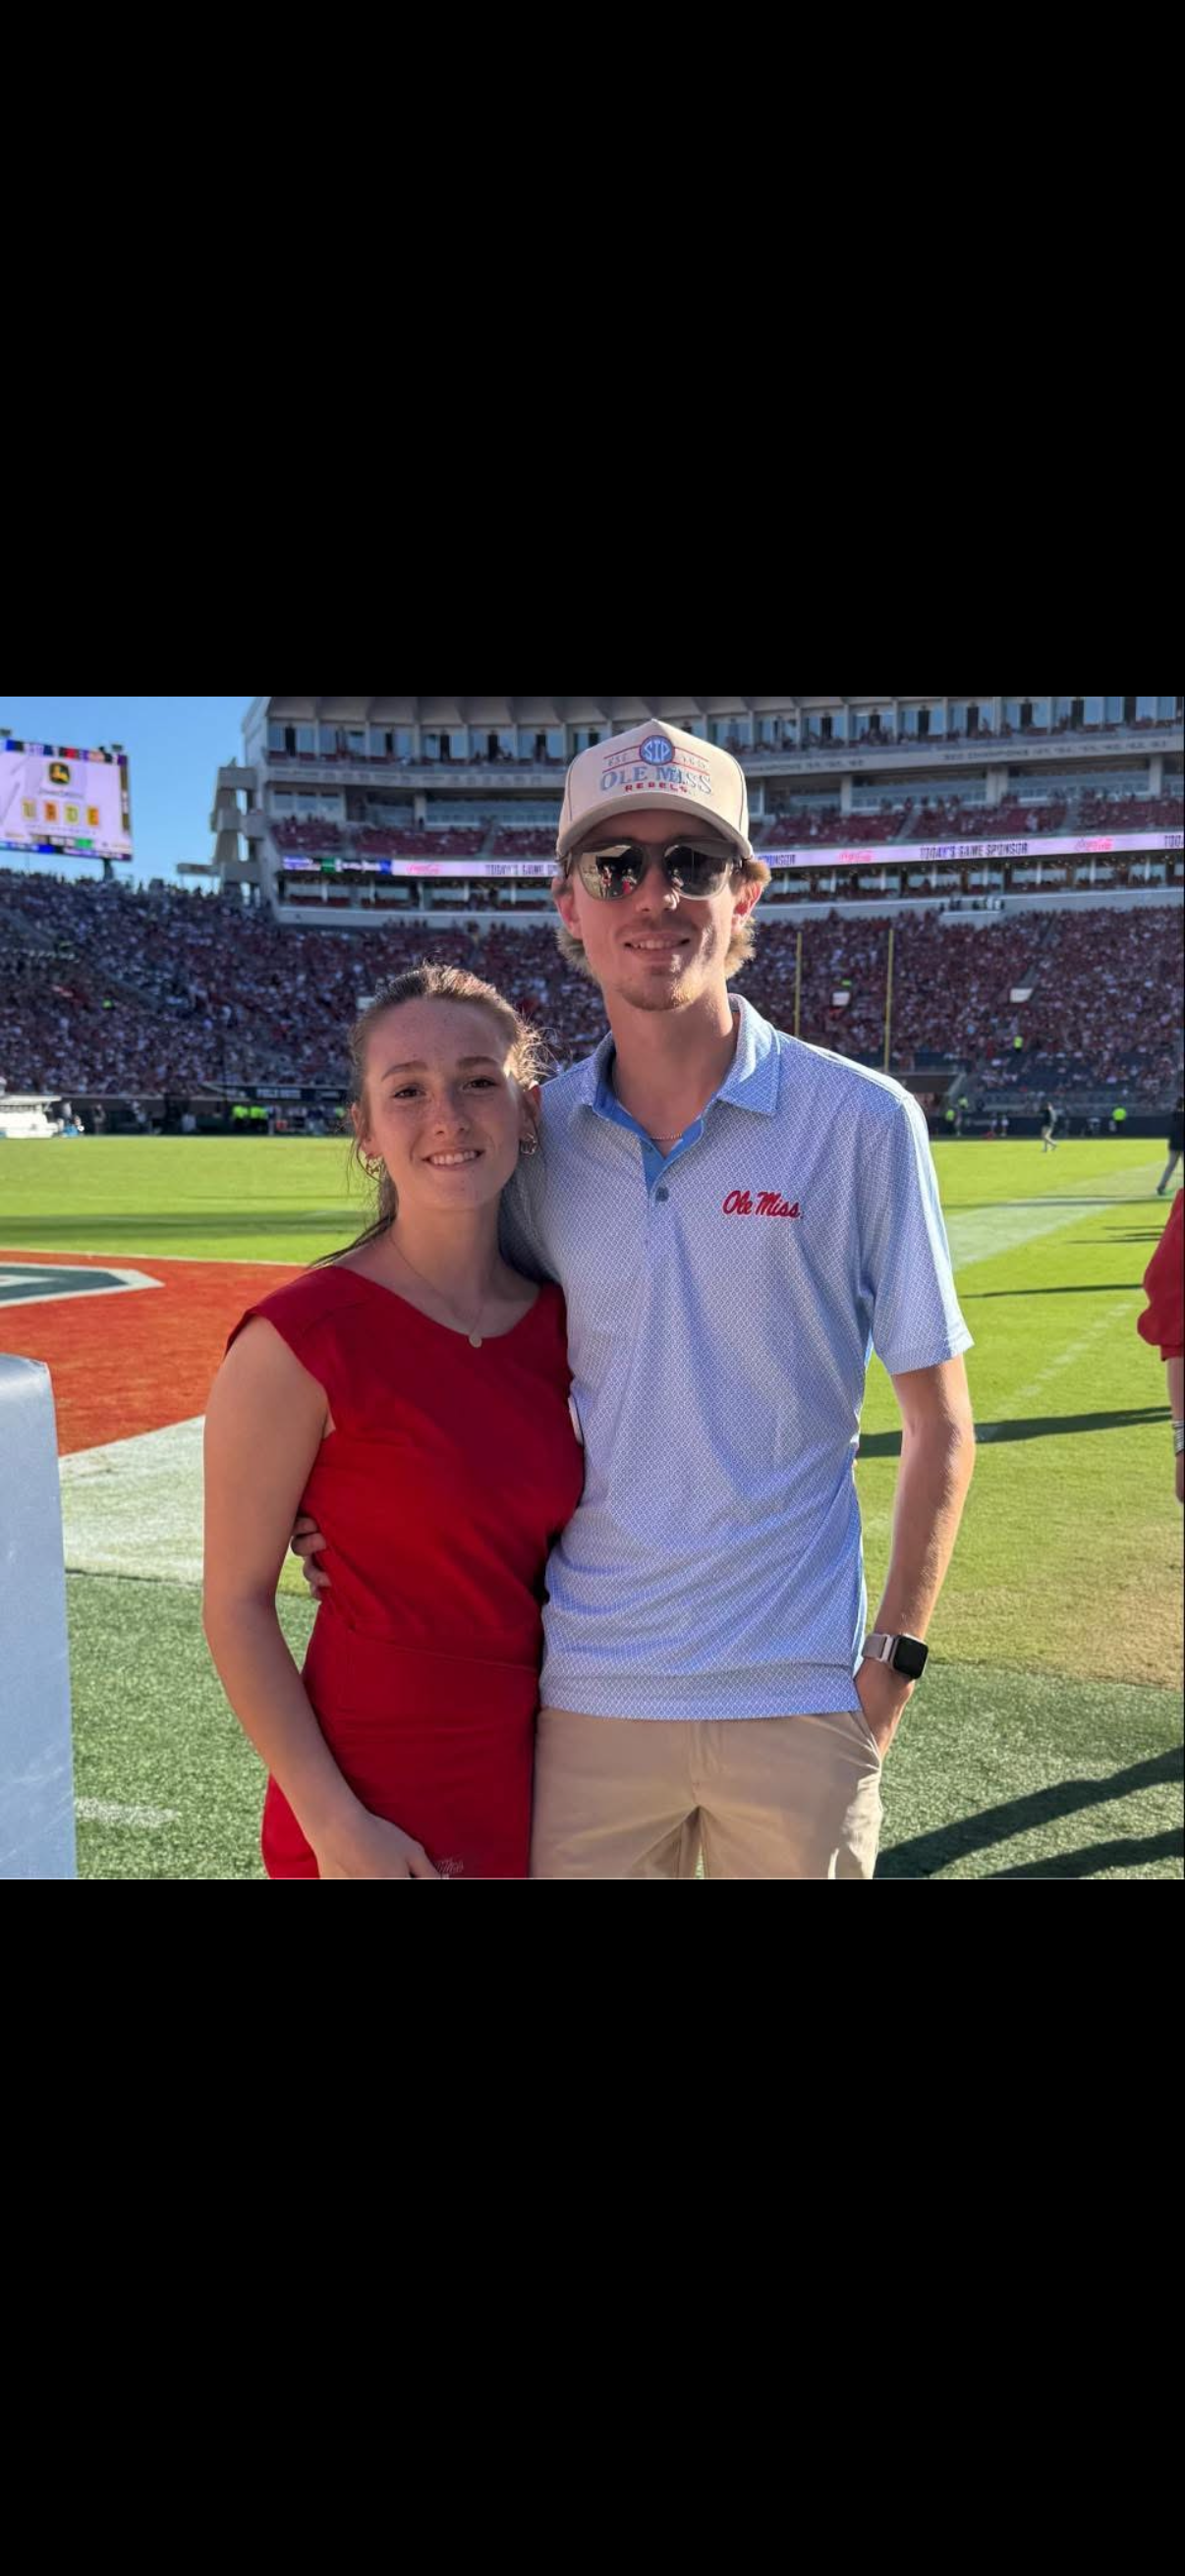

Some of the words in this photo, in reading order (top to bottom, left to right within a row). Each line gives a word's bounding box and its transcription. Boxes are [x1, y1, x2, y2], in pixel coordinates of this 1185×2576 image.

[644, 739, 671, 763] SIP
[600, 766, 649, 792] OLE
[655, 766, 712, 794] MISS
[625, 781, 689, 794] REBELS
[987, 842, 1028, 857] SPONSOR
[722, 1190, 754, 1215] Ole
[755, 1191, 801, 1218] Miss
